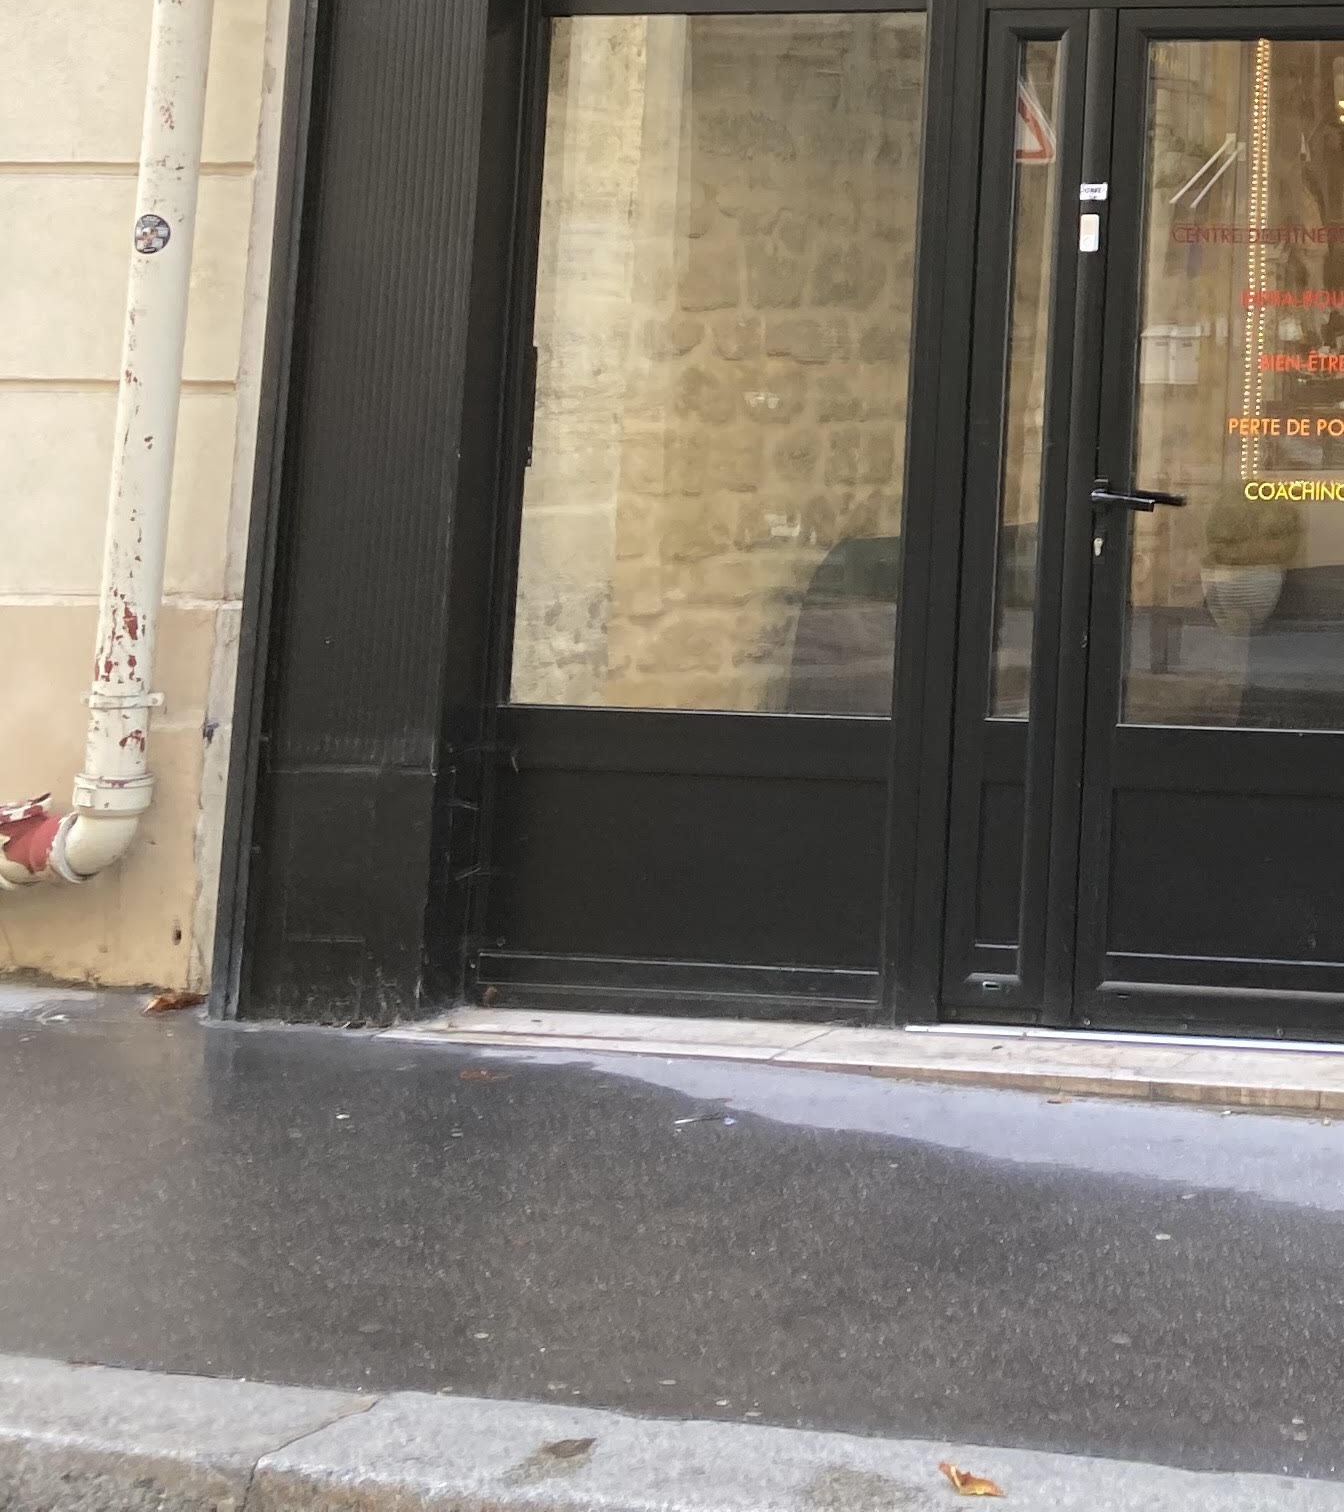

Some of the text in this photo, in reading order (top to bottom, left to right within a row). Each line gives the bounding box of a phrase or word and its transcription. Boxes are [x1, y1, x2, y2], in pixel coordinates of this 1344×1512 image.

[1172, 226, 1243, 243] CENTRE
[1228, 418, 1281, 436] PERTE
[1286, 418, 1310, 436] DE
